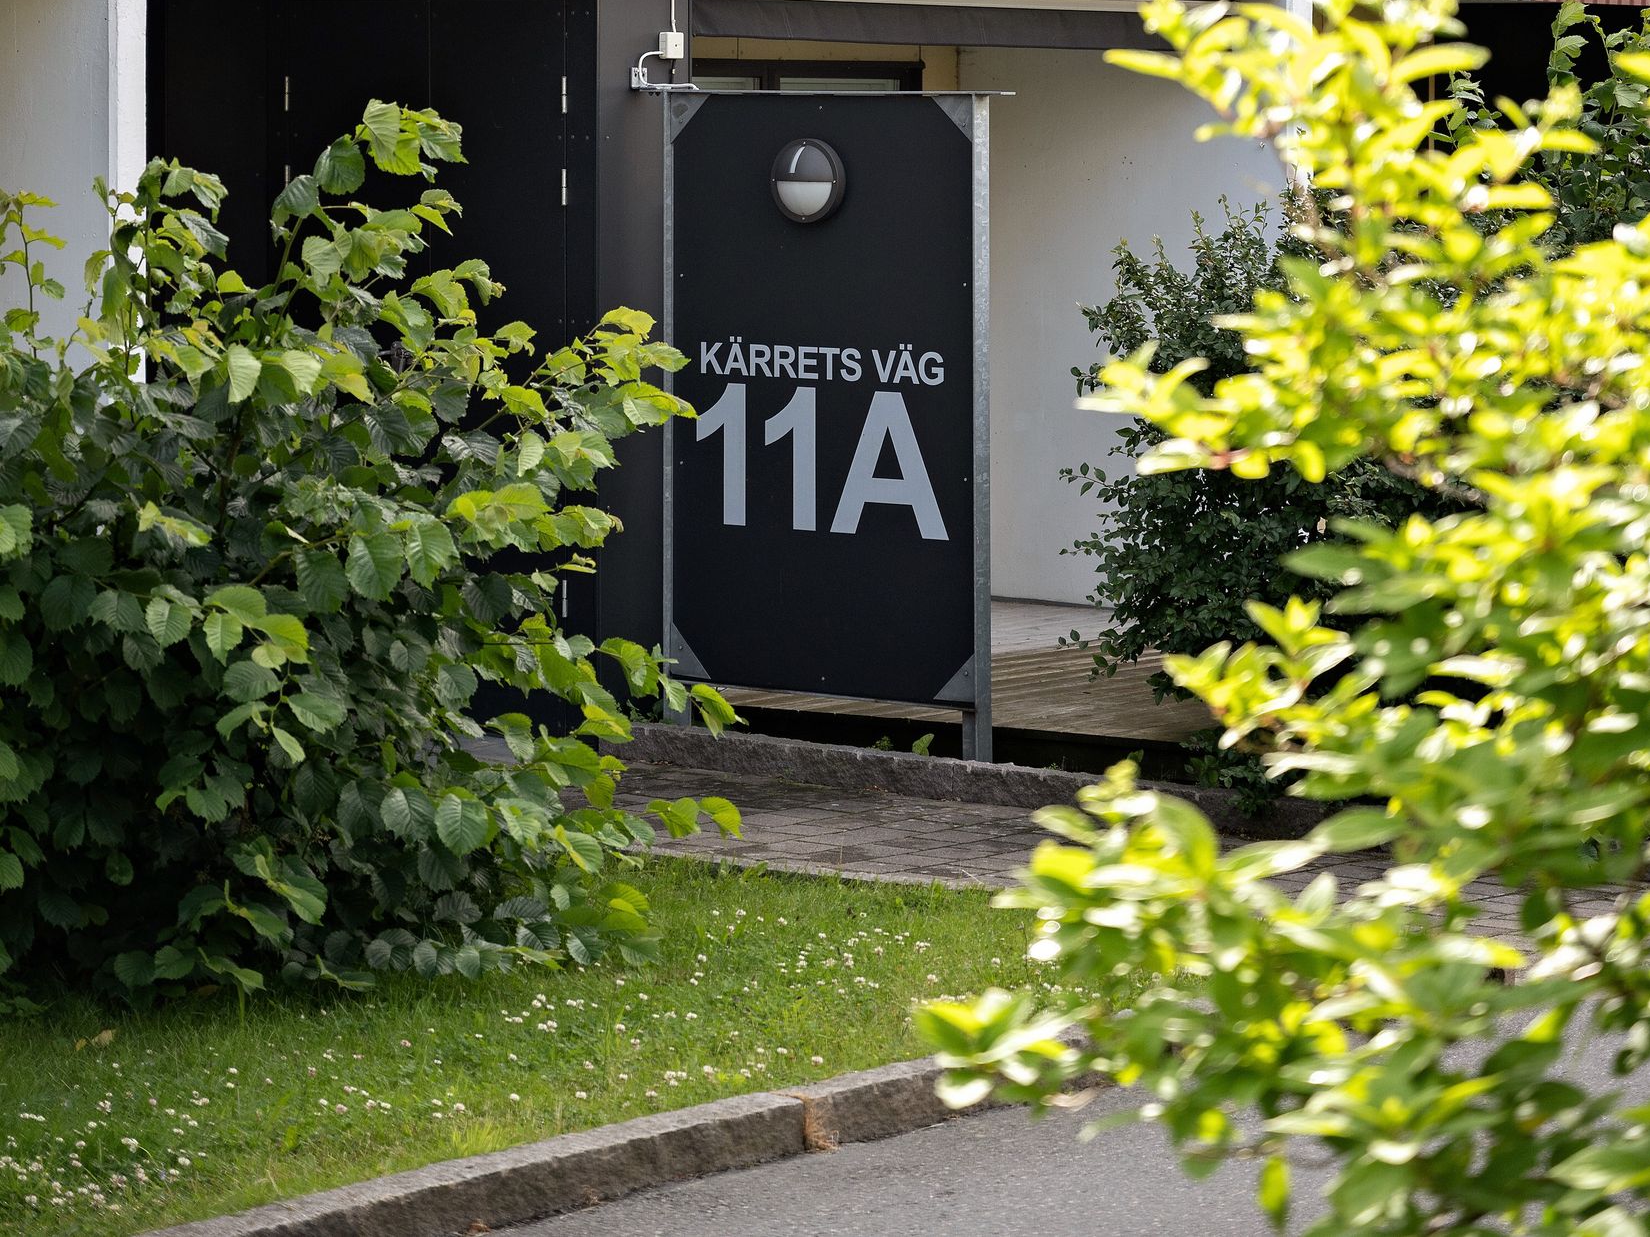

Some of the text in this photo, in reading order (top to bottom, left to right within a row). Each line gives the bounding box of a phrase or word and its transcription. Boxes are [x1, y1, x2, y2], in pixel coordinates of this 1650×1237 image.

[700, 335, 945, 385] KÄRRETS VÄG
[696, 383, 950, 541] 11A
